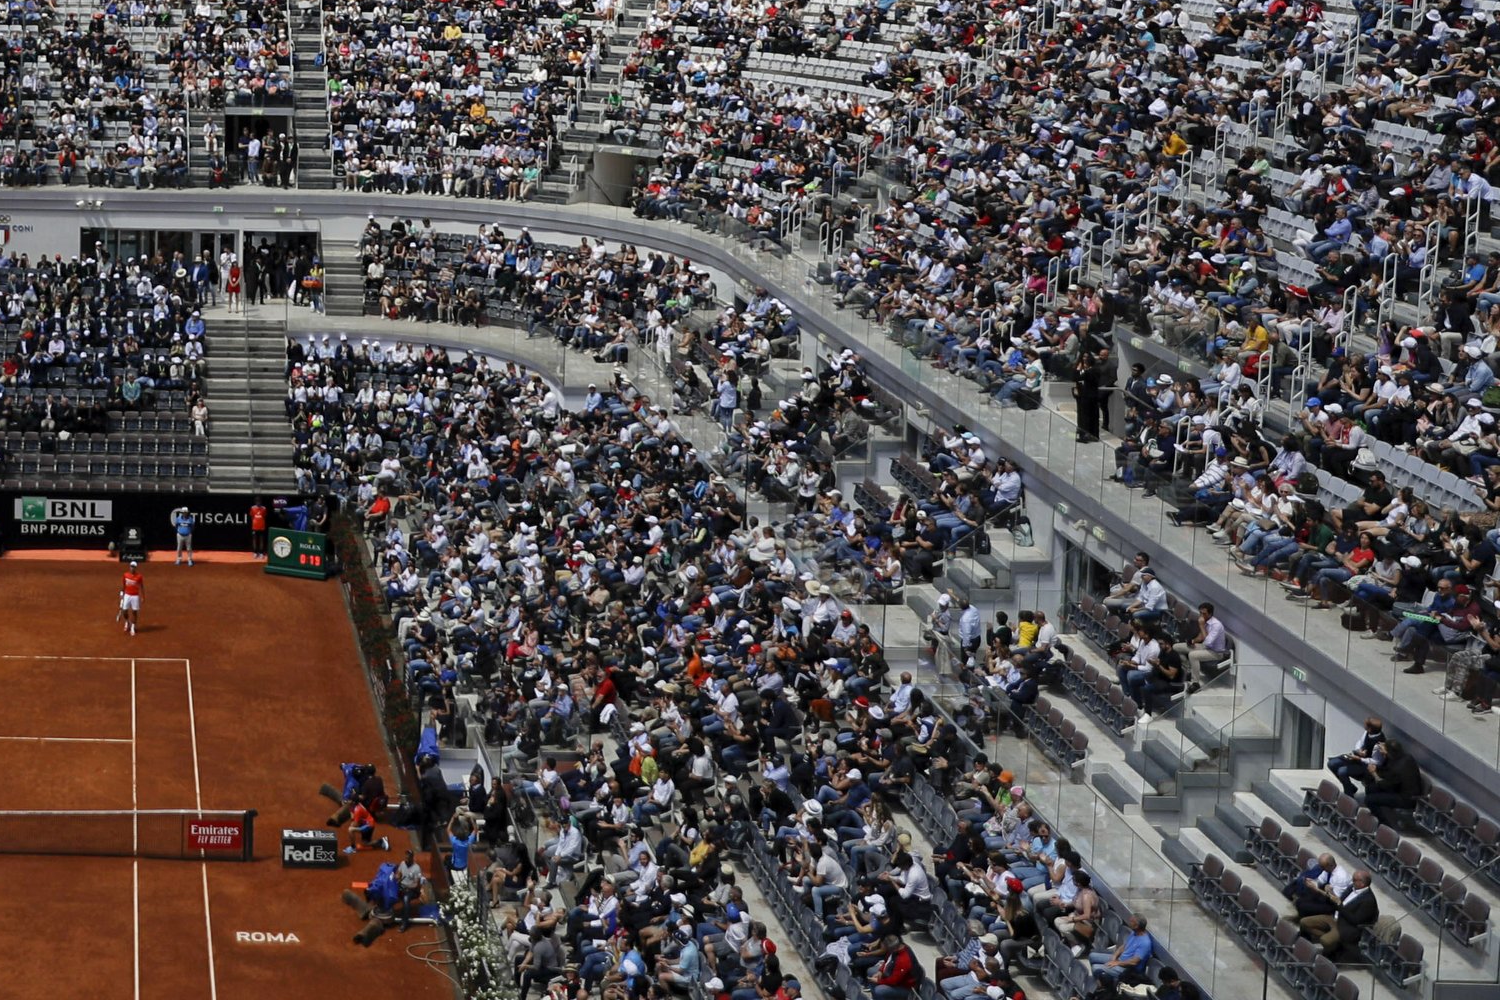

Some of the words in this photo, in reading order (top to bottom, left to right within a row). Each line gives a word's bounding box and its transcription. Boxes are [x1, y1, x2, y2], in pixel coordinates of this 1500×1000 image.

[12, 224, 33, 232] CONI
[51, 501, 105, 518] BNL
[190, 512, 248, 524] TISCALI
[20, 523, 47, 534] BNP
[50, 524, 105, 535] PARIBAS
[299, 542, 321, 551] ROLEX
[190, 824, 239, 836] Emirates
[197, 835, 208, 843] FLY
[209, 835, 232, 844] BETTER
[284, 845, 335, 862] FedEx
[236, 931, 301, 943] ROMA
